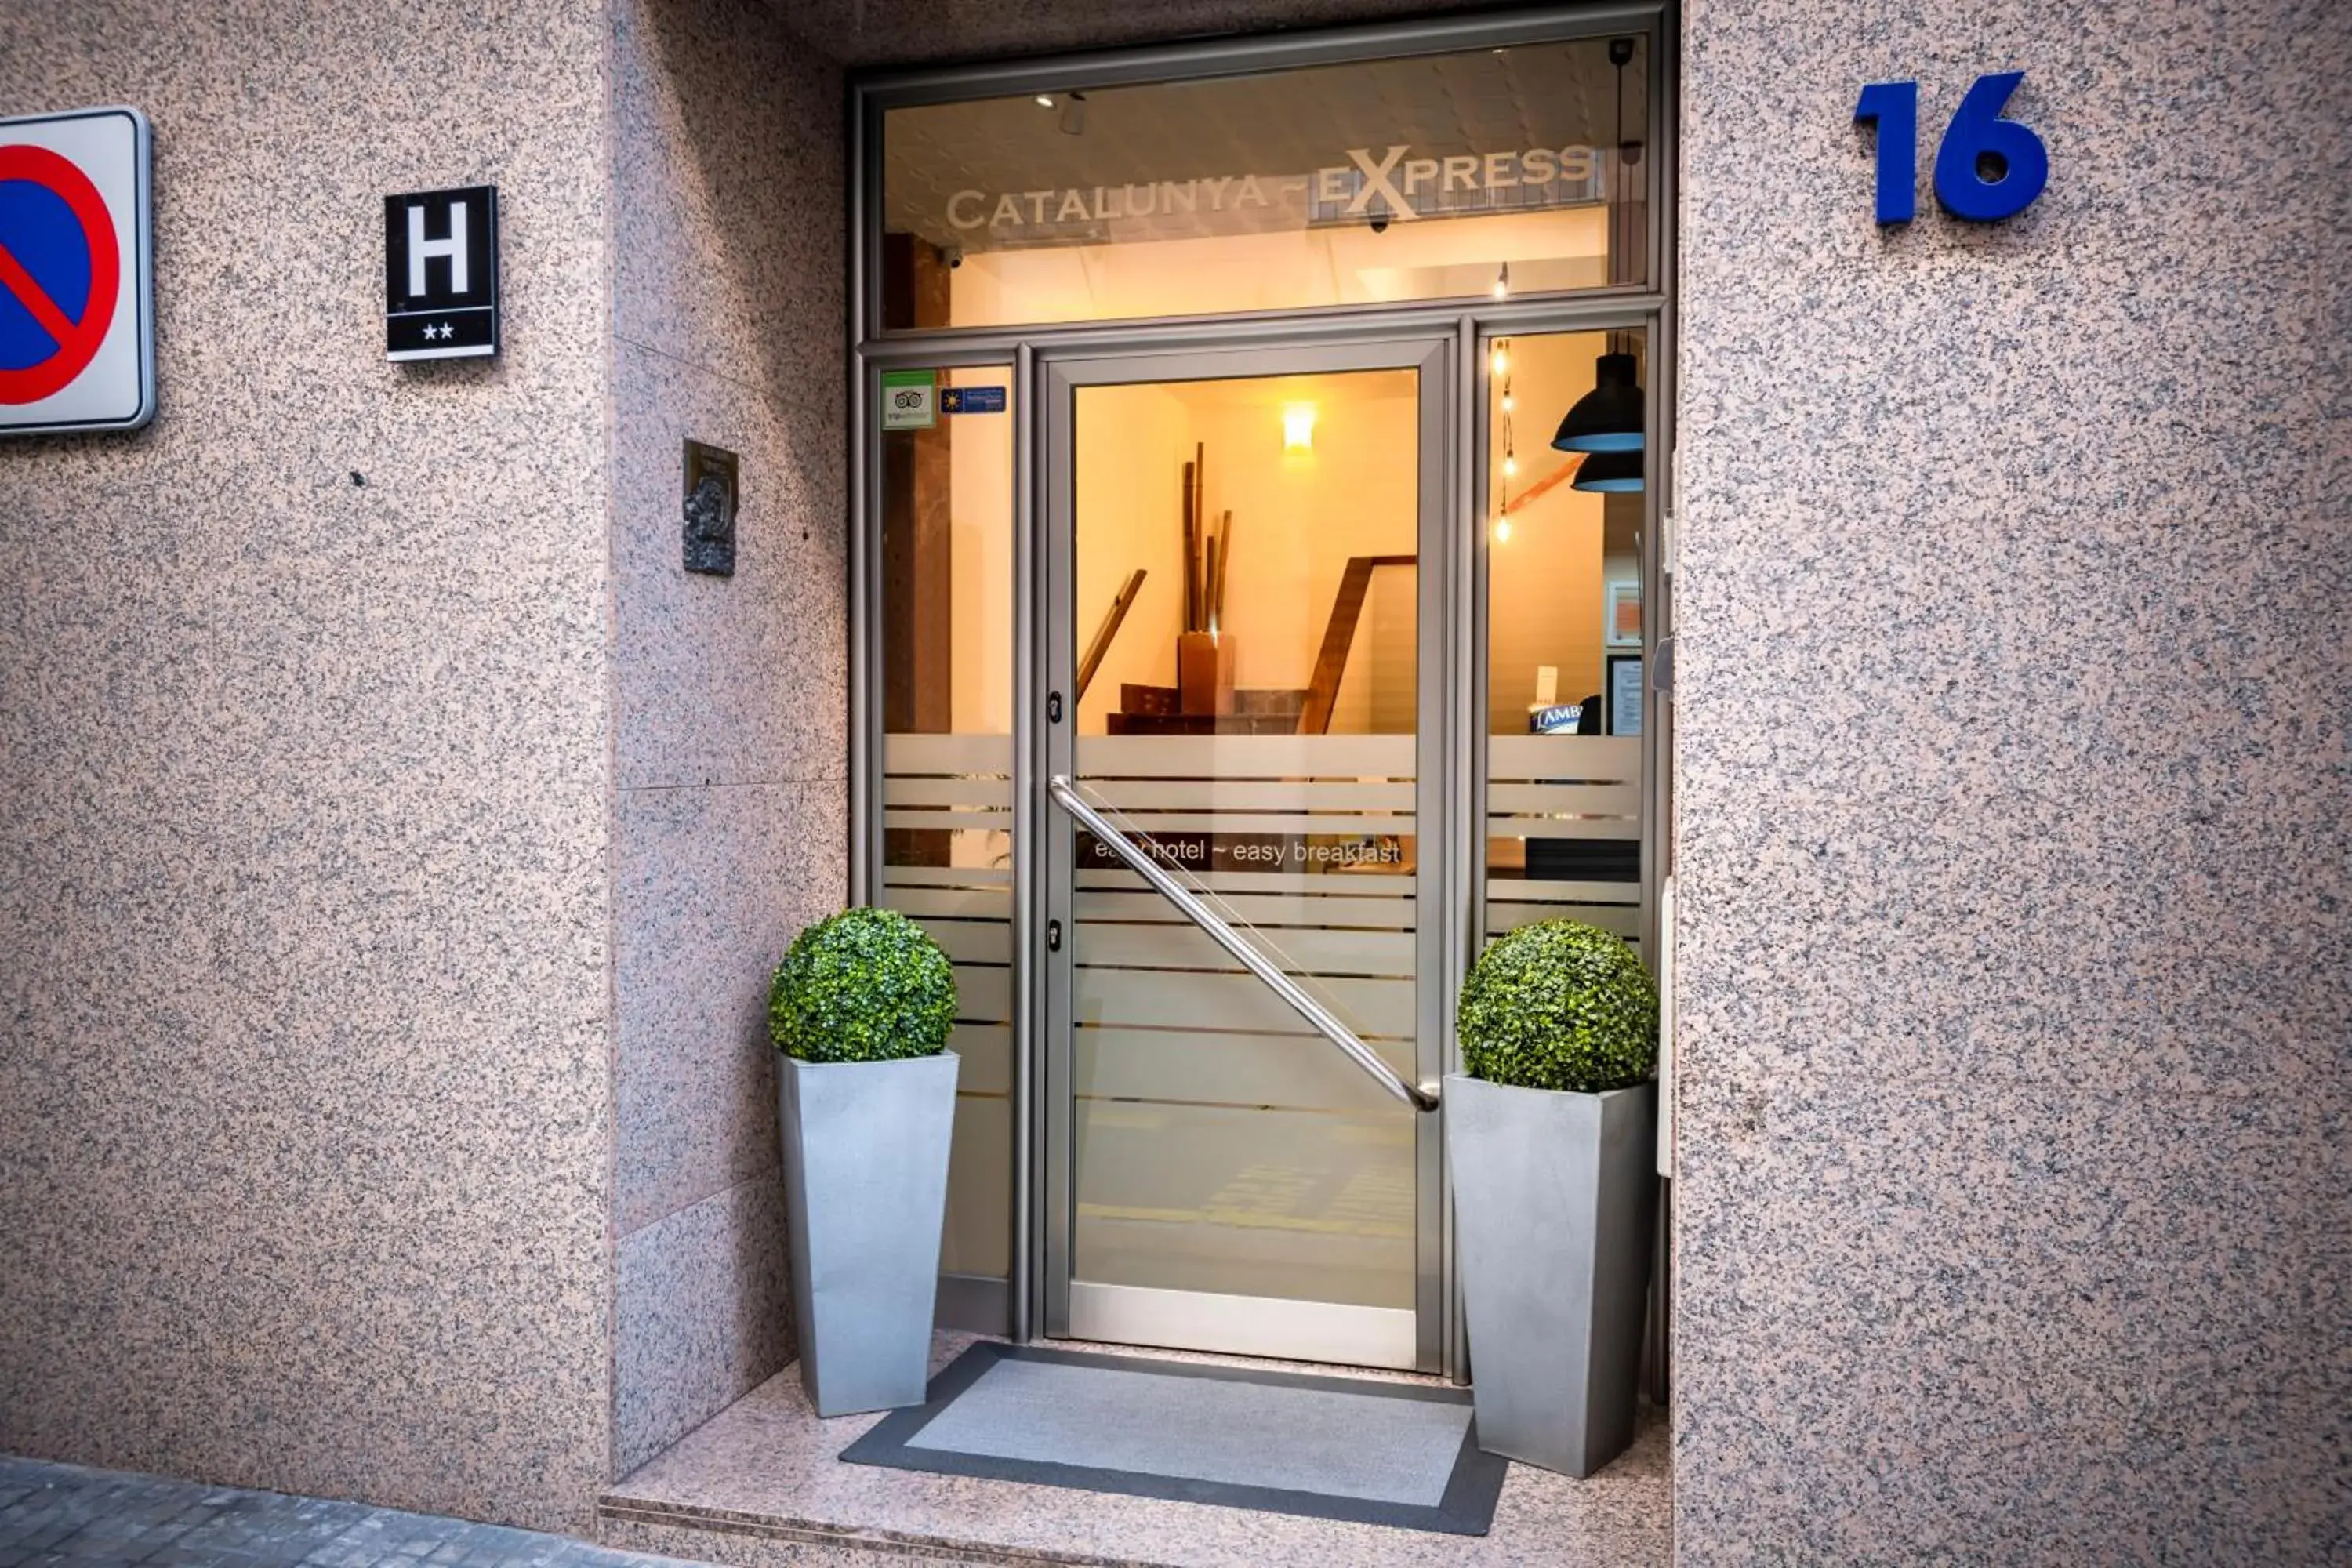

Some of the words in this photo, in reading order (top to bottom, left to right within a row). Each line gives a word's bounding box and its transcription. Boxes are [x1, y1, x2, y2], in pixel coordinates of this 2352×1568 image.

[946, 173, 1269, 230] CATALUNYA
[1317, 144, 1595, 220] EXPRESS
[1853, 70, 2049, 226] 16
[407, 201, 469, 297] H
[1152, 839, 1205, 860] hotel
[1232, 843, 1287, 866] easy
[1294, 840, 1400, 863] breakfast
